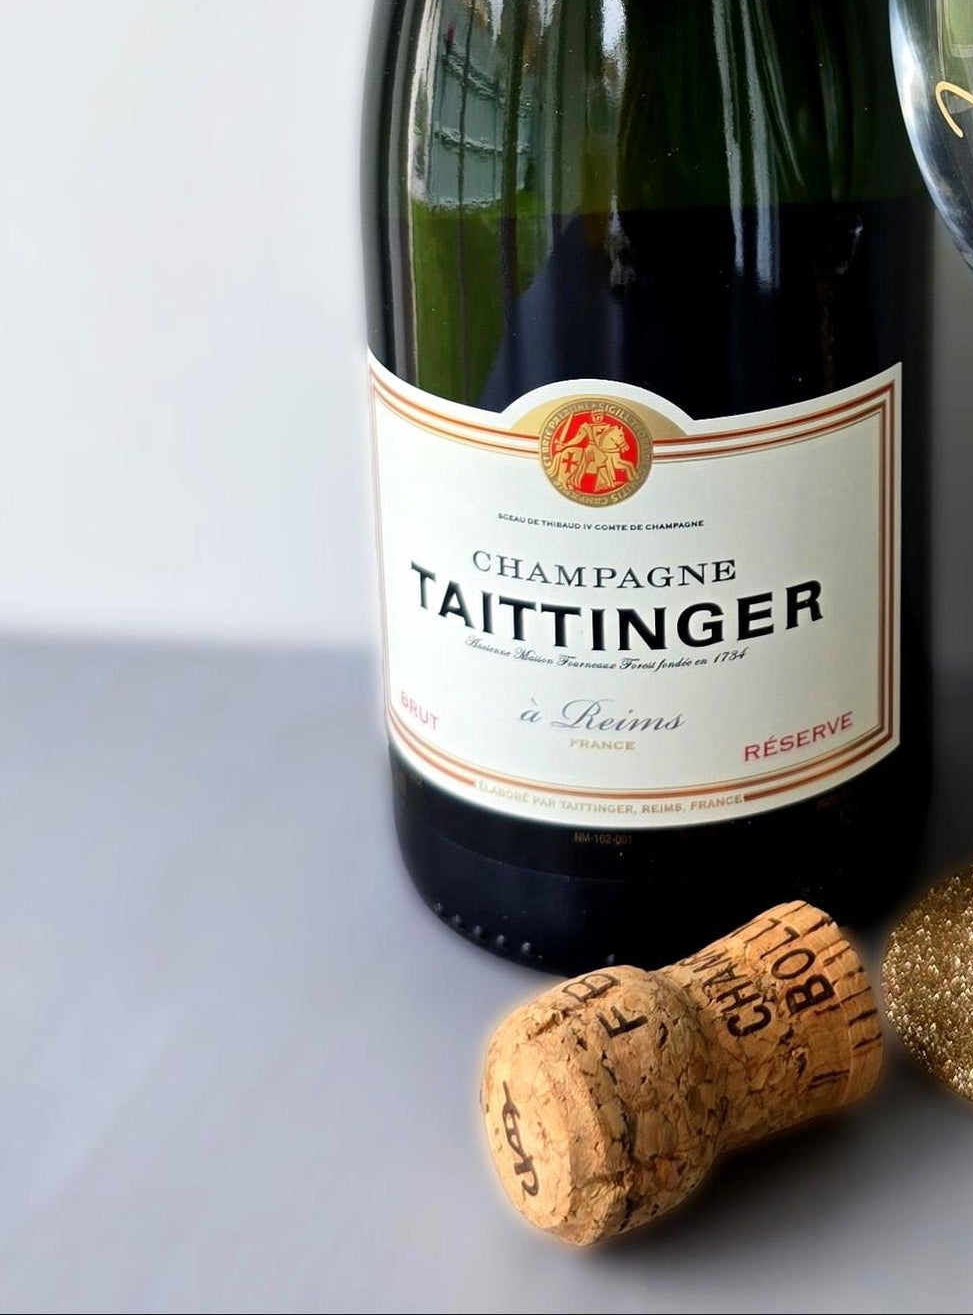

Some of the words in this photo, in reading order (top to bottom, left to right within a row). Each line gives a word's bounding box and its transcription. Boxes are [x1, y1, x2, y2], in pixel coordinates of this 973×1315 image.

[527, 517, 539, 526] DE
[541, 519, 581, 530] THIBAUD
[594, 523, 628, 531] COMTE
[645, 520, 705, 531] CHAMPAGNE
[472, 550, 737, 590] CHAMPAGNE
[410, 560, 824, 652] TAITTINGER
[694, 658, 707, 666] en
[714, 646, 749, 664] 1734
[401, 689, 440, 732] BRUT
[519, 697, 542, 723] à
[550, 698, 687, 732] Reims
[569, 738, 637, 751] FRANCE
[743, 710, 854, 762] RÉSERVE
[532, 794, 556, 809] PAR
[560, 799, 638, 816] TAITTINGER,
[641, 803, 687, 815] REIMS,
[690, 793, 743, 811] FRANCE
